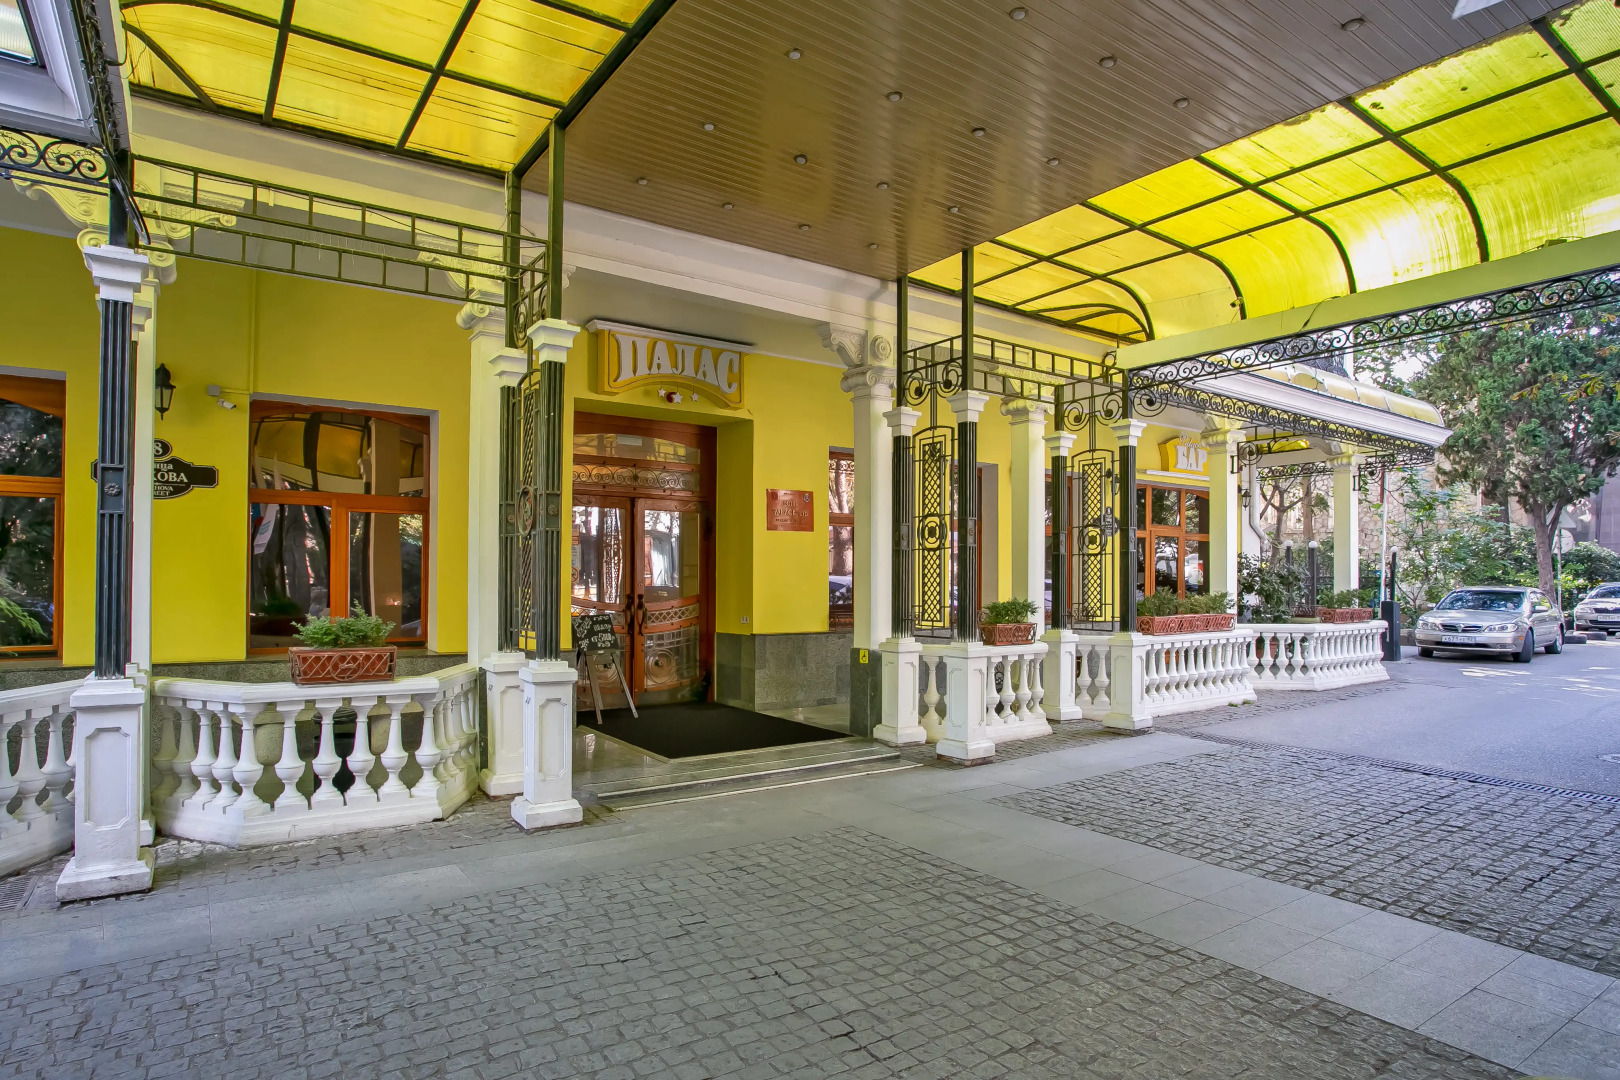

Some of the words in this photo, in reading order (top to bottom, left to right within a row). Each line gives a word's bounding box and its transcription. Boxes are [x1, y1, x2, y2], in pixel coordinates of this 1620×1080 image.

[614, 333, 740, 394] ПАЛАС
[154, 463, 174, 472] ица
[1176, 445, 1208, 472] БАР
